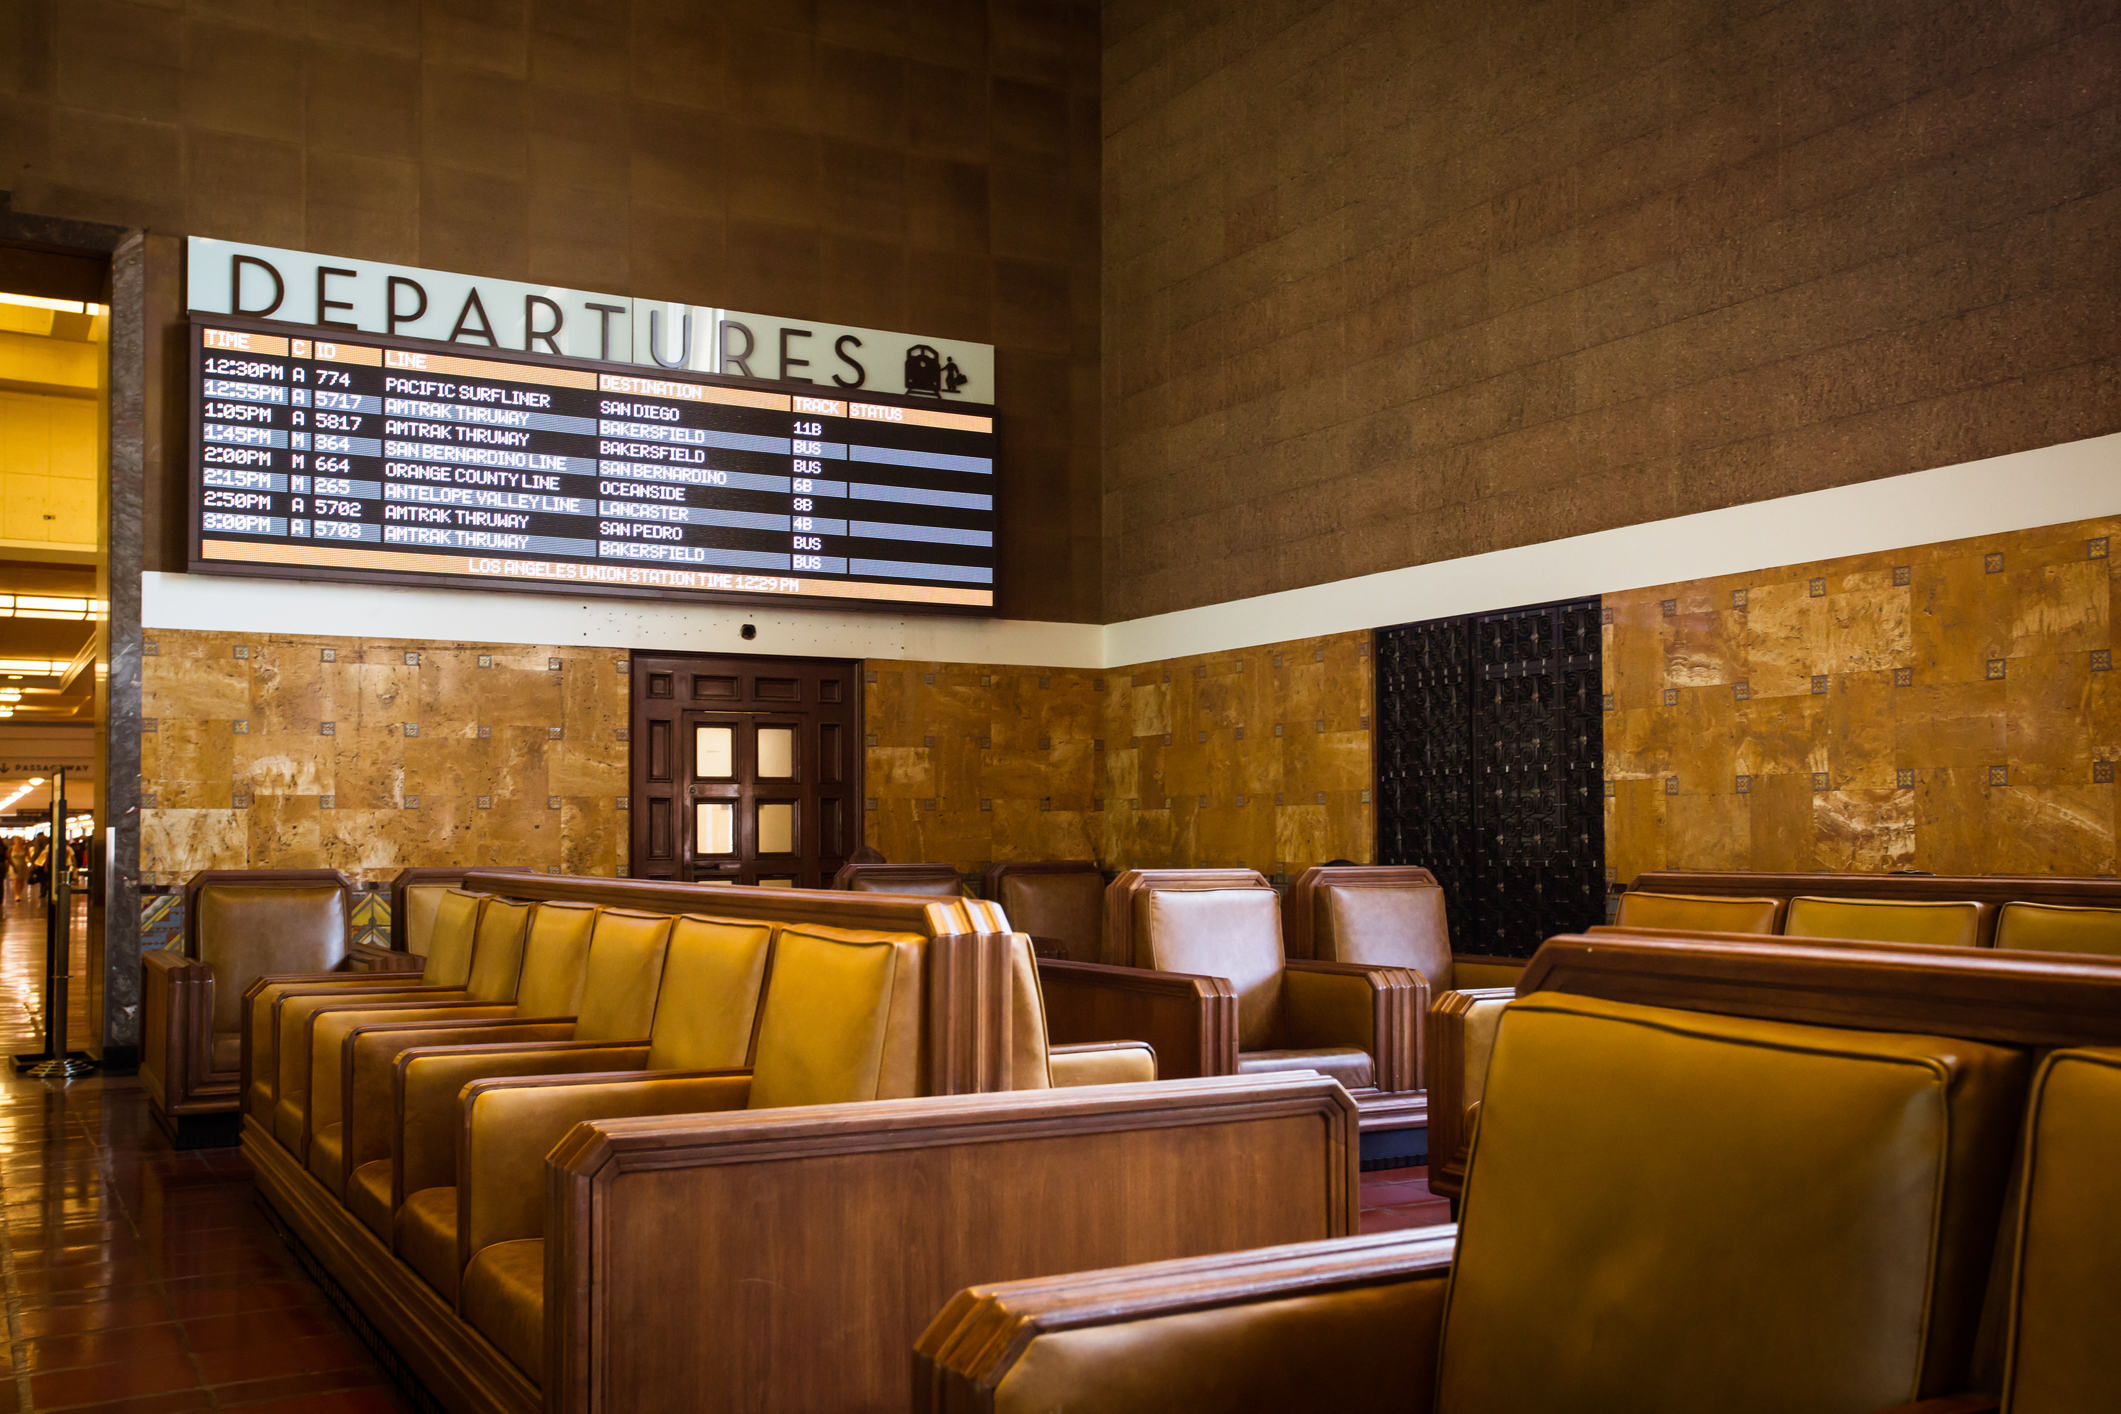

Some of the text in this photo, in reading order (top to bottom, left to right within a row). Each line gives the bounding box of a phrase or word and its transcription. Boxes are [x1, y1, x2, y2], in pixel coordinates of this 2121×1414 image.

[231, 255, 865, 389] DEPARTURES
[205, 330, 250, 349] TIME
[293, 341, 305, 355] C
[316, 343, 336, 358] ID
[205, 358, 284, 380] 12:30PM
[386, 351, 427, 369] LINE
[293, 368, 305, 382] A
[316, 370, 351, 387] 774
[204, 380, 283, 402] 12:55PM
[385, 378, 550, 408] PACIFIC SURFLINER
[600, 374, 702, 399] DESTINATION
[292, 389, 304, 404] A
[315, 391, 362, 409] 5717
[205, 402, 272, 423] 1:05PM
[385, 398, 529, 426] AMTRAK THRUWAY
[600, 401, 680, 421] SAN DIEGO
[794, 398, 839, 414] TRACK
[850, 403, 903, 421] STATUS
[292, 411, 304, 426] A
[315, 413, 362, 431] 5817
[204, 424, 271, 445] 1:45PM
[385, 420, 529, 447] AMTRAK THRUWAY
[600, 421, 705, 443] BAKERSFIELD
[793, 422, 822, 436] 11B
[292, 433, 304, 448] M
[315, 435, 350, 451] 364
[793, 440, 821, 455] BUS
[204, 447, 271, 466] 2:00PM
[385, 440, 567, 471] SAN BERNARDINO LINE
[600, 441, 705, 463] BAKERSFIELD
[292, 454, 304, 469] M
[315, 457, 350, 473] 664
[793, 460, 821, 474] BUS
[204, 469, 271, 488] 2:15PM
[385, 462, 560, 491] ORANGE COUNTY LINE
[600, 461, 727, 485] SAN BERNARDINO
[291, 477, 304, 491] M
[314, 478, 350, 494] 265
[600, 481, 686, 501] OCEANSIDE
[793, 479, 812, 493] 6B
[204, 491, 271, 510] 2:50PM
[292, 498, 304, 513] A
[385, 483, 580, 512] ANTELOPE VALLEY LINE
[793, 498, 812, 512] 8B
[315, 499, 362, 517] 5702
[385, 505, 529, 528] AMTRAK THRUWAY
[600, 501, 689, 521] LANCASTER
[203, 513, 271, 532] 3:00PM
[291, 520, 304, 535] A
[314, 521, 362, 538] 5703
[600, 522, 682, 540] SAN PEDRO
[793, 517, 812, 530] 4B
[385, 526, 529, 549] AMTRAK THRUWAY
[793, 536, 821, 550] BUS
[600, 542, 704, 562] BAKERSFIELD
[793, 556, 821, 569] BUS
[468, 558, 799, 592] LOS ANGELES UNION STATION TIME 12:29 PM
